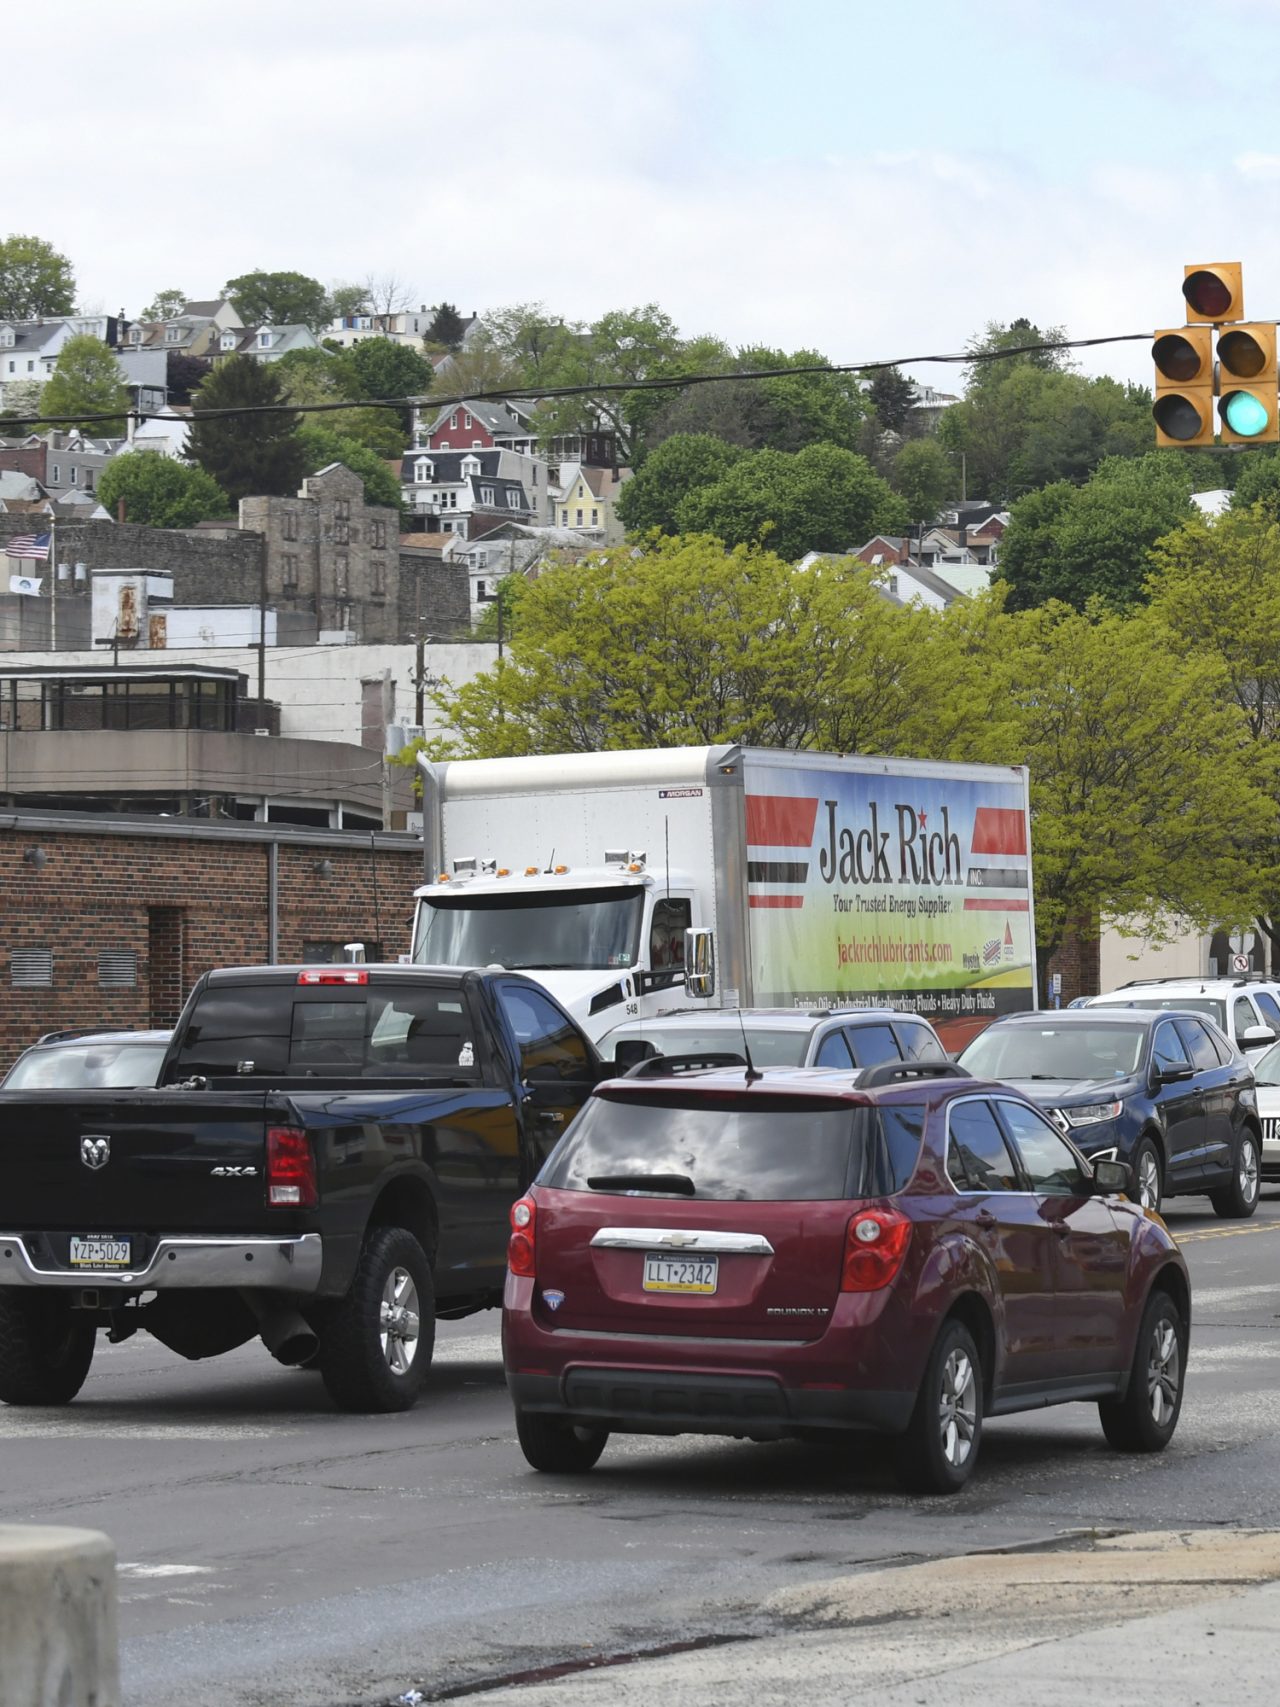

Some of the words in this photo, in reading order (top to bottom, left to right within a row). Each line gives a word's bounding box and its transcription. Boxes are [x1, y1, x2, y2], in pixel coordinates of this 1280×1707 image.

[666, 788, 702, 797] MORGAN
[819, 800, 893, 885] Jack
[894, 804, 964, 887] Rich
[970, 869, 984, 885] INC.
[833, 894, 853, 912] Your
[855, 894, 887, 913] Trusted
[889, 896, 917, 918] Energy
[837, 936, 953, 970] jackrichlubricants.com
[626, 1003, 638, 1015] 548
[917, 994, 937, 1011] Fluids
[942, 994, 961, 1012] Heavy
[961, 993, 976, 1011] Duty
[977, 992, 996, 1009] Fluids
[767, 1307, 815, 1316] EQUINOX
